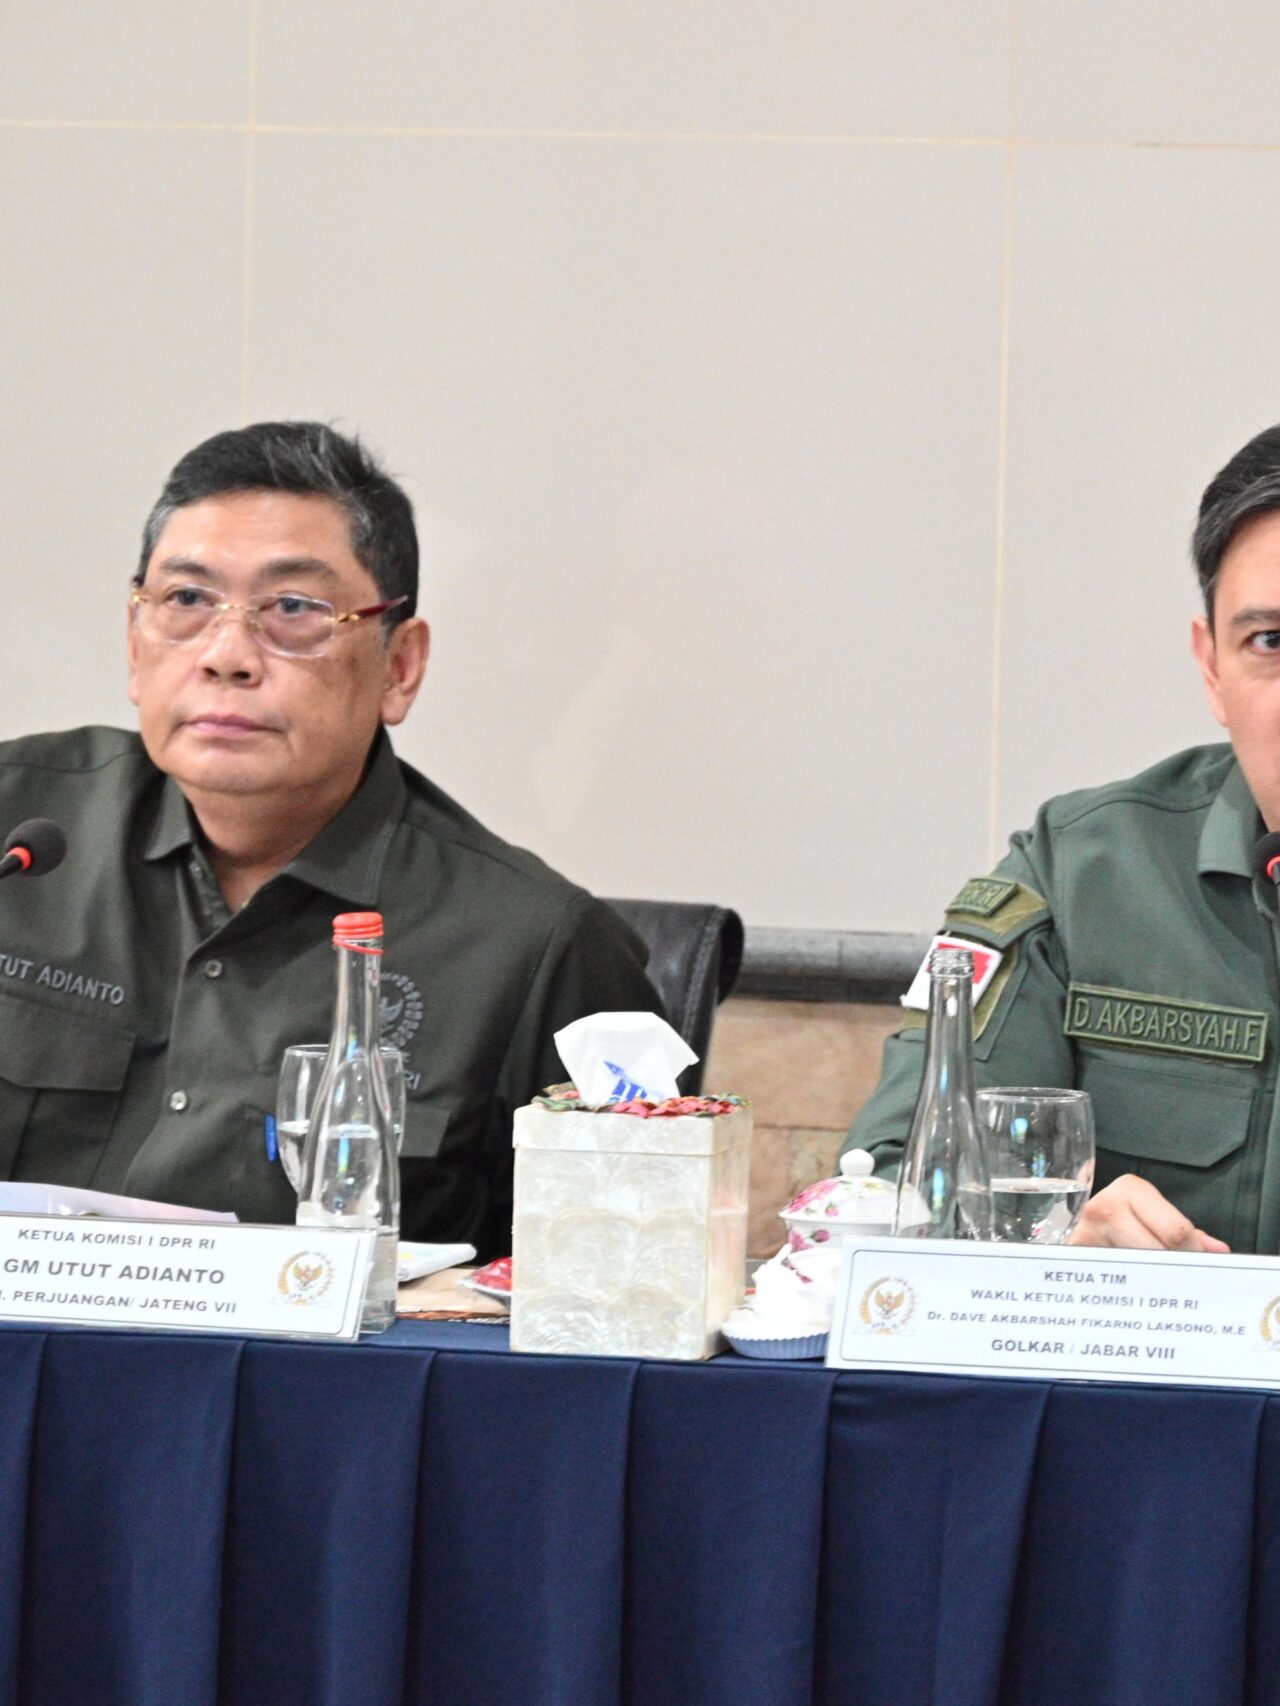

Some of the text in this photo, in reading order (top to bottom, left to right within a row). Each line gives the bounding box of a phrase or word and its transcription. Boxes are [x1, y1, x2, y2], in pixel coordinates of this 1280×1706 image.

[36, 965, 125, 1006] ADIANTO
[18, 1229, 75, 1242] KETUA
[82, 1232, 142, 1245] KOMISI
[159, 1236, 192, 1248] DPR
[198, 1238, 215, 1249] RI
[4, 1258, 225, 1284] GM UTUT ADIANTO
[1044, 1271, 1127, 1285] KETUA TIM
[139, 1297, 207, 1312] JATENG
[215, 1302, 237, 1313] VII
[971, 1289, 1018, 1302] WAKIL
[1024, 1291, 1074, 1304] KETUA
[1080, 1294, 1134, 1307] KOMISI
[1149, 1297, 1178, 1309] DPR
[1184, 1299, 1199, 1310] RI
[928, 1310, 1246, 1335] Dr. DAVE AKBARSHAH FIKARNO LAKSONO, M.E
[991, 1339, 1064, 1354] GOLKAR
[1080, 1343, 1139, 1358] JABAR
[1146, 1346, 1175, 1359] VIII
